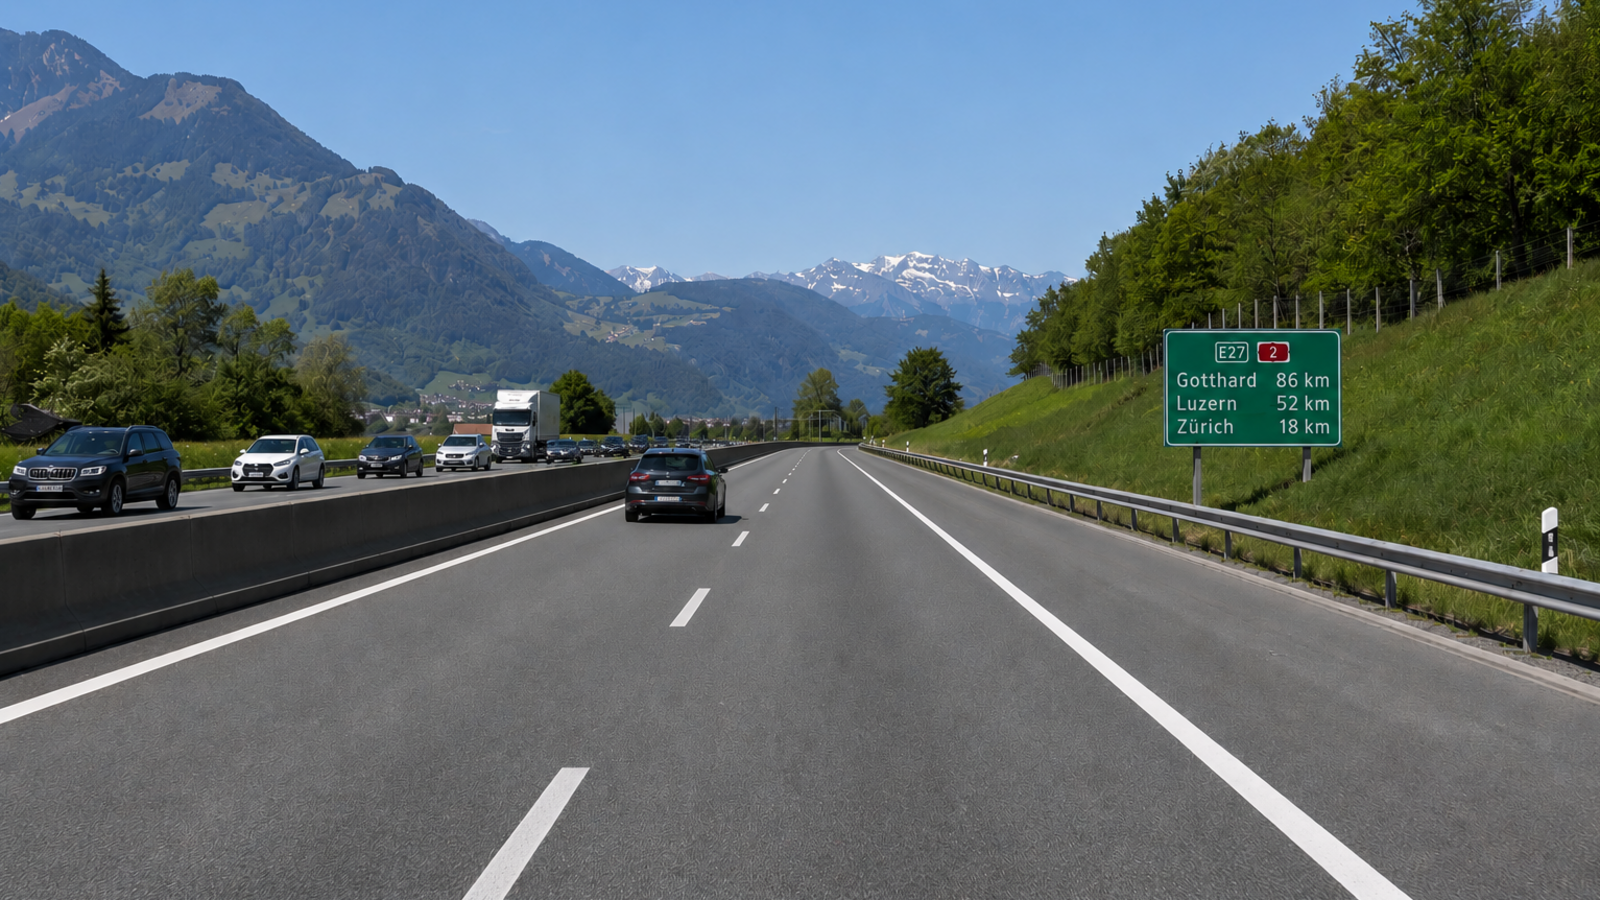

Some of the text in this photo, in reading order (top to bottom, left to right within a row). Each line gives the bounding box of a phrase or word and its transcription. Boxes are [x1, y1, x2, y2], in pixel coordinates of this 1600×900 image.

[1219, 346, 1245, 359] E27
[1269, 346, 1277, 359] 2
[1177, 372, 1330, 388] Gotthard 86 km
[1177, 395, 1330, 411] Luzern 52 km
[1177, 418, 1330, 434] Zürich 18 km
